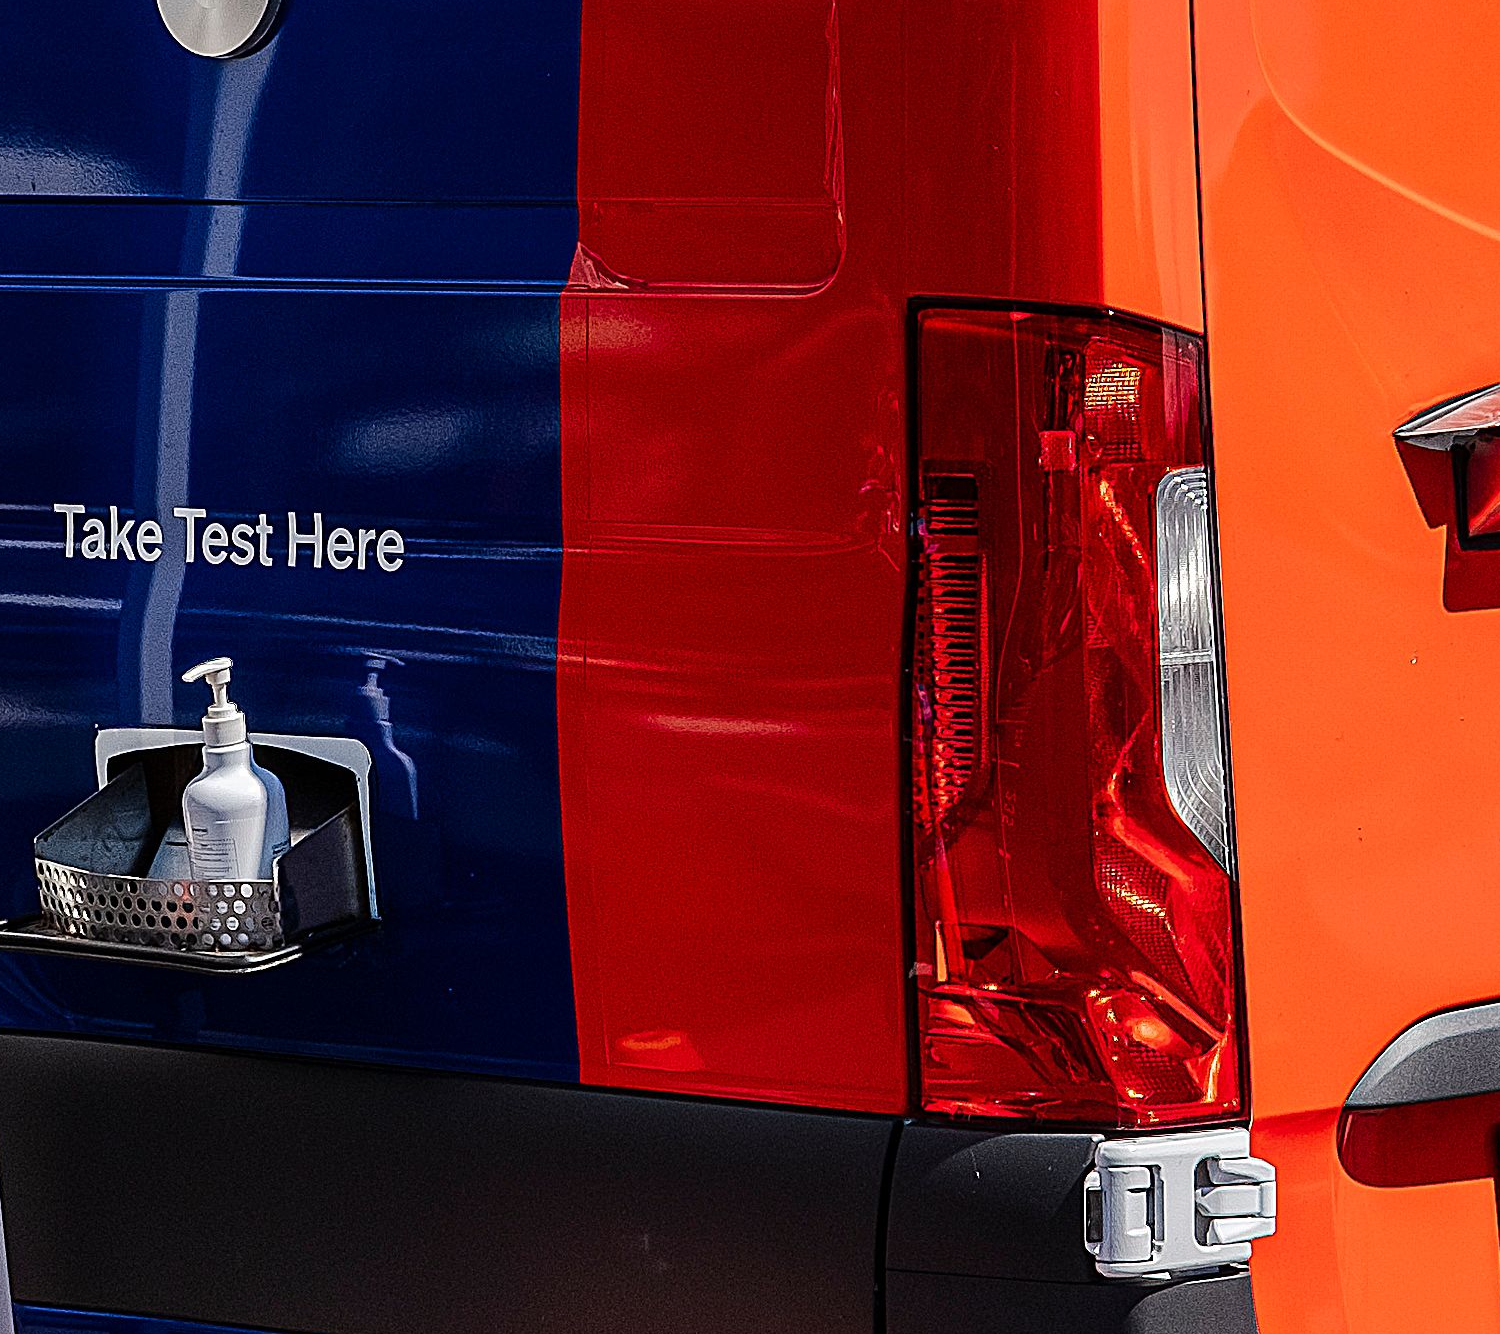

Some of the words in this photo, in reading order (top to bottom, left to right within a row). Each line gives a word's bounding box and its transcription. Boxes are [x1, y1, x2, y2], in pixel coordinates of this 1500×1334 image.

[53, 503, 164, 562] Take
[173, 507, 274, 567] Test
[287, 511, 405, 572] Here
